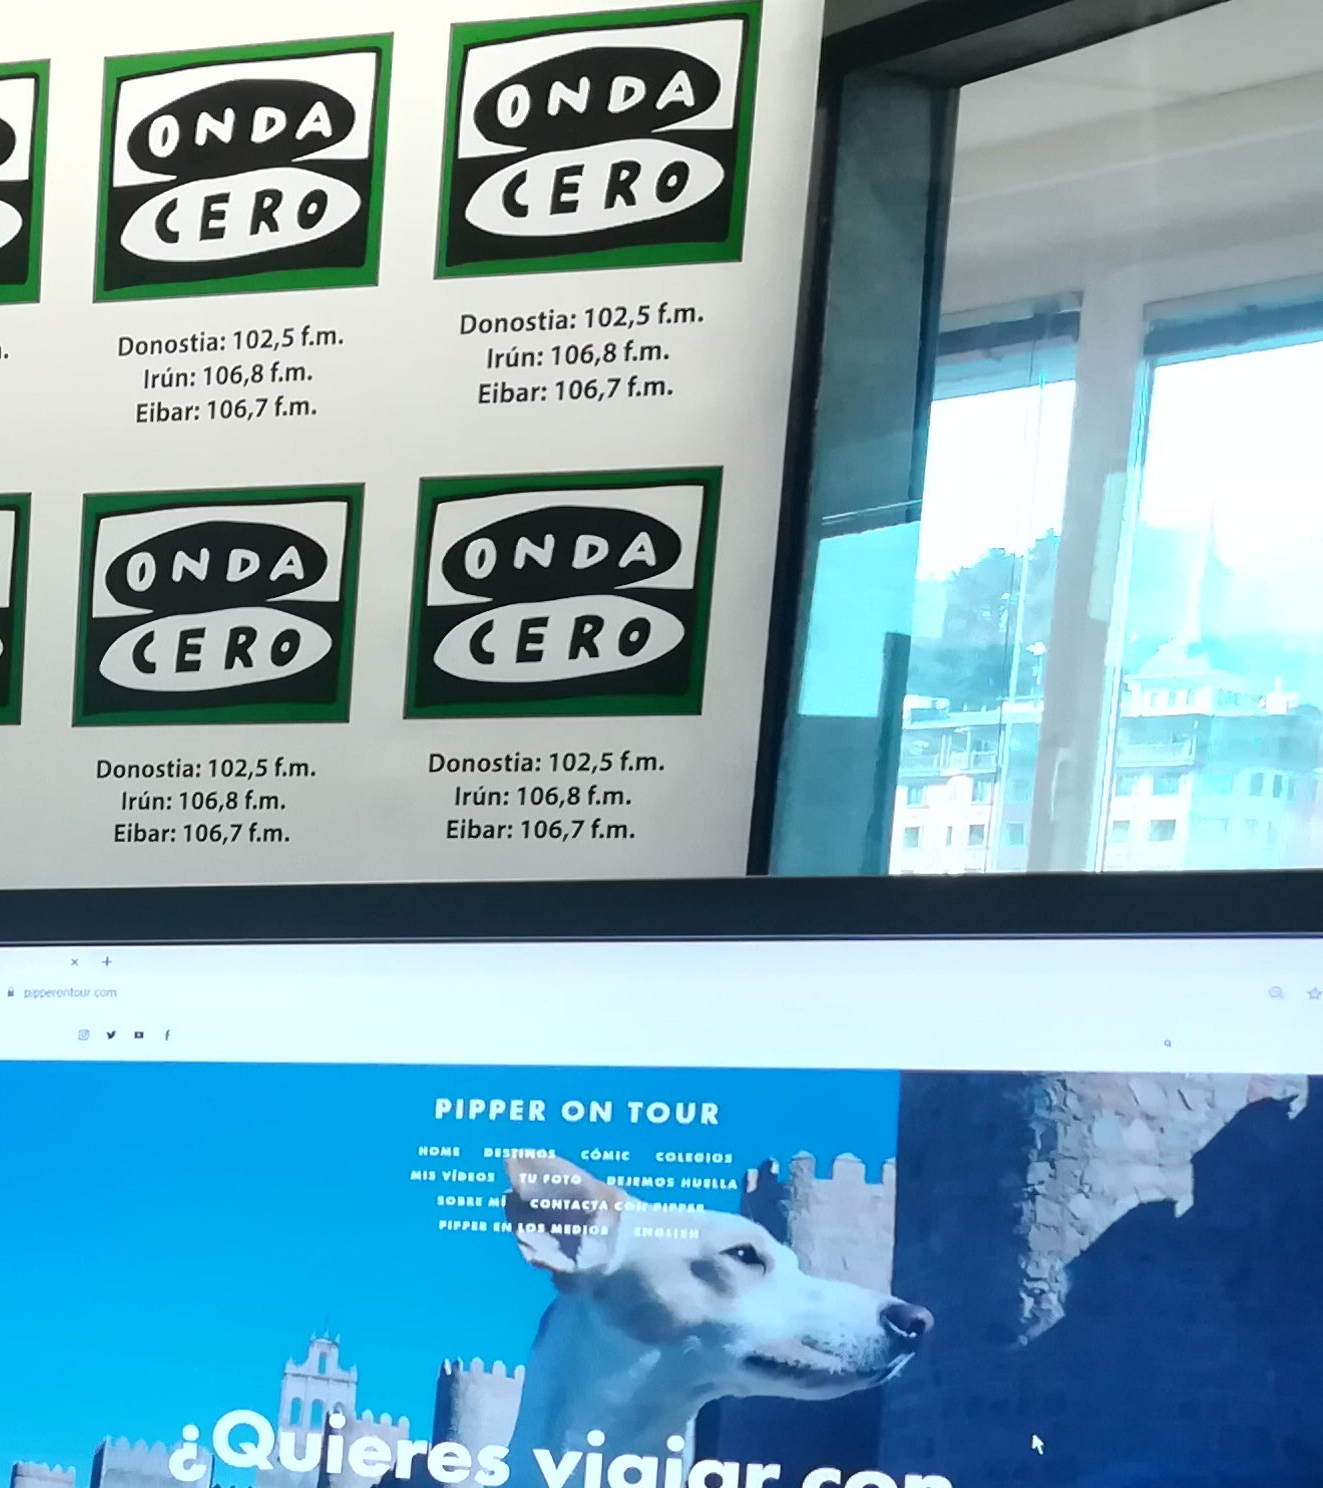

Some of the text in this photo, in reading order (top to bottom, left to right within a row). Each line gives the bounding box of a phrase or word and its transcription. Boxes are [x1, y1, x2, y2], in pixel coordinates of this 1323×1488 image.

[497, 70, 694, 128] ONDA
[149, 101, 332, 157] ONDA
[503, 161, 689, 217] CERO
[156, 190, 327, 243] CERO
[459, 301, 704, 335] Donostia: 102,5 f.m.
[118, 324, 344, 357] Donostia: 102,5 f.m.
[487, 338, 670, 369] Irún: 106,8 f.m.
[144, 360, 313, 390] Irún: 106,8 f.m.
[478, 374, 674, 405] Eibar: 106,7 f.m.
[136, 395, 317, 424] Eibar: 106,7 f.m.
[127, 546, 304, 591] ONDA
[465, 532, 656, 579] ONDA
[133, 627, 300, 674] CERO
[470, 615, 650, 664] CERO
[96, 756, 316, 781] Donostia: 102,5 f.m.
[428, 749, 665, 775] Donostia: 102,5 f.m.
[121, 789, 286, 813] Irún: 106,8 f.m.
[454, 784, 632, 809] Irún: 106,8 f.m.
[114, 821, 290, 846] Eibar: 106,7 f.m.
[446, 817, 635, 843] Eibar: 106,7 f.m.
[23, 987, 117, 999] pipperontour.com
[435, 1098, 719, 1125] PIPPER ON TOUR
[418, 1146, 733, 1164] HOME DESTINOS CÓMIC COLEGIOS
[410, 1168, 738, 1190] MIS VÍDEOS TU FOTO DEJEMOS HUELLA
[437, 1195, 483, 1207] SOBRE
[530, 1198, 608, 1211] CONTACTA
[438, 1220, 488, 1232] PIPPER
[493, 1222, 512, 1233] EN
[517, 1223, 545, 1234] LOS
[550, 1224, 608, 1236] MEDIOS
[168, 1409, 511, 1487] ¿Quieres
